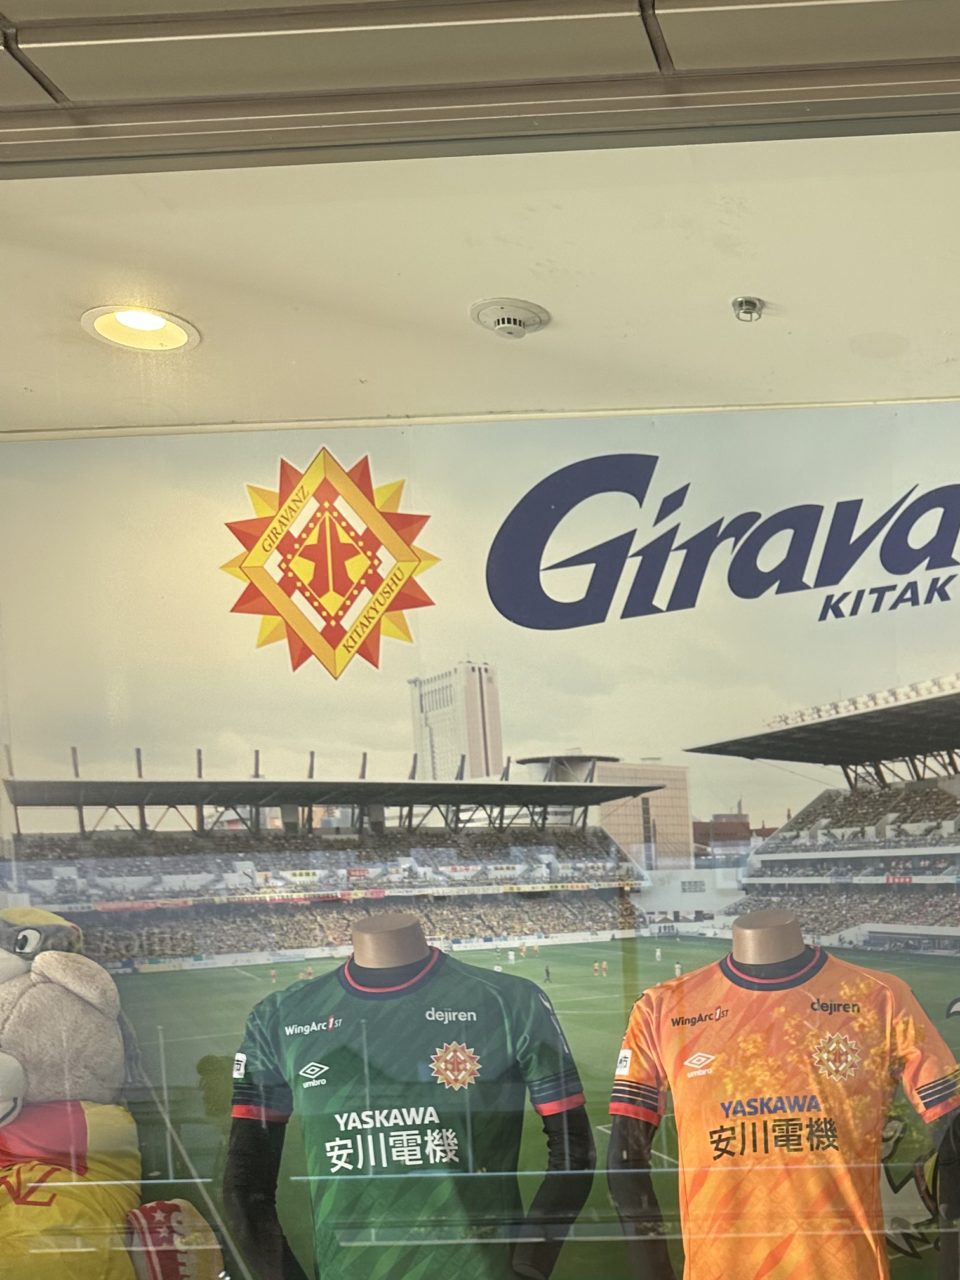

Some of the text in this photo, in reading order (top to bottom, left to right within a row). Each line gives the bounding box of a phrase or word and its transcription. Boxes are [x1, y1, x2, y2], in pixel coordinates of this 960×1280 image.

[261, 485, 310, 553] GIRAVANZ
[342, 567, 405, 654] KITAKYUSHU
[425, 1007, 477, 1024] dejiren
[810, 998, 860, 1015] dejiren
[302, 1077, 327, 1088] umbro
[687, 1067, 713, 1078] umbro
[334, 1106, 440, 1132] YASKAWA
[720, 1094, 821, 1119] YASKAWA
[324, 1128, 460, 1174] 安川電機
[709, 1117, 839, 1161] 安川電機
